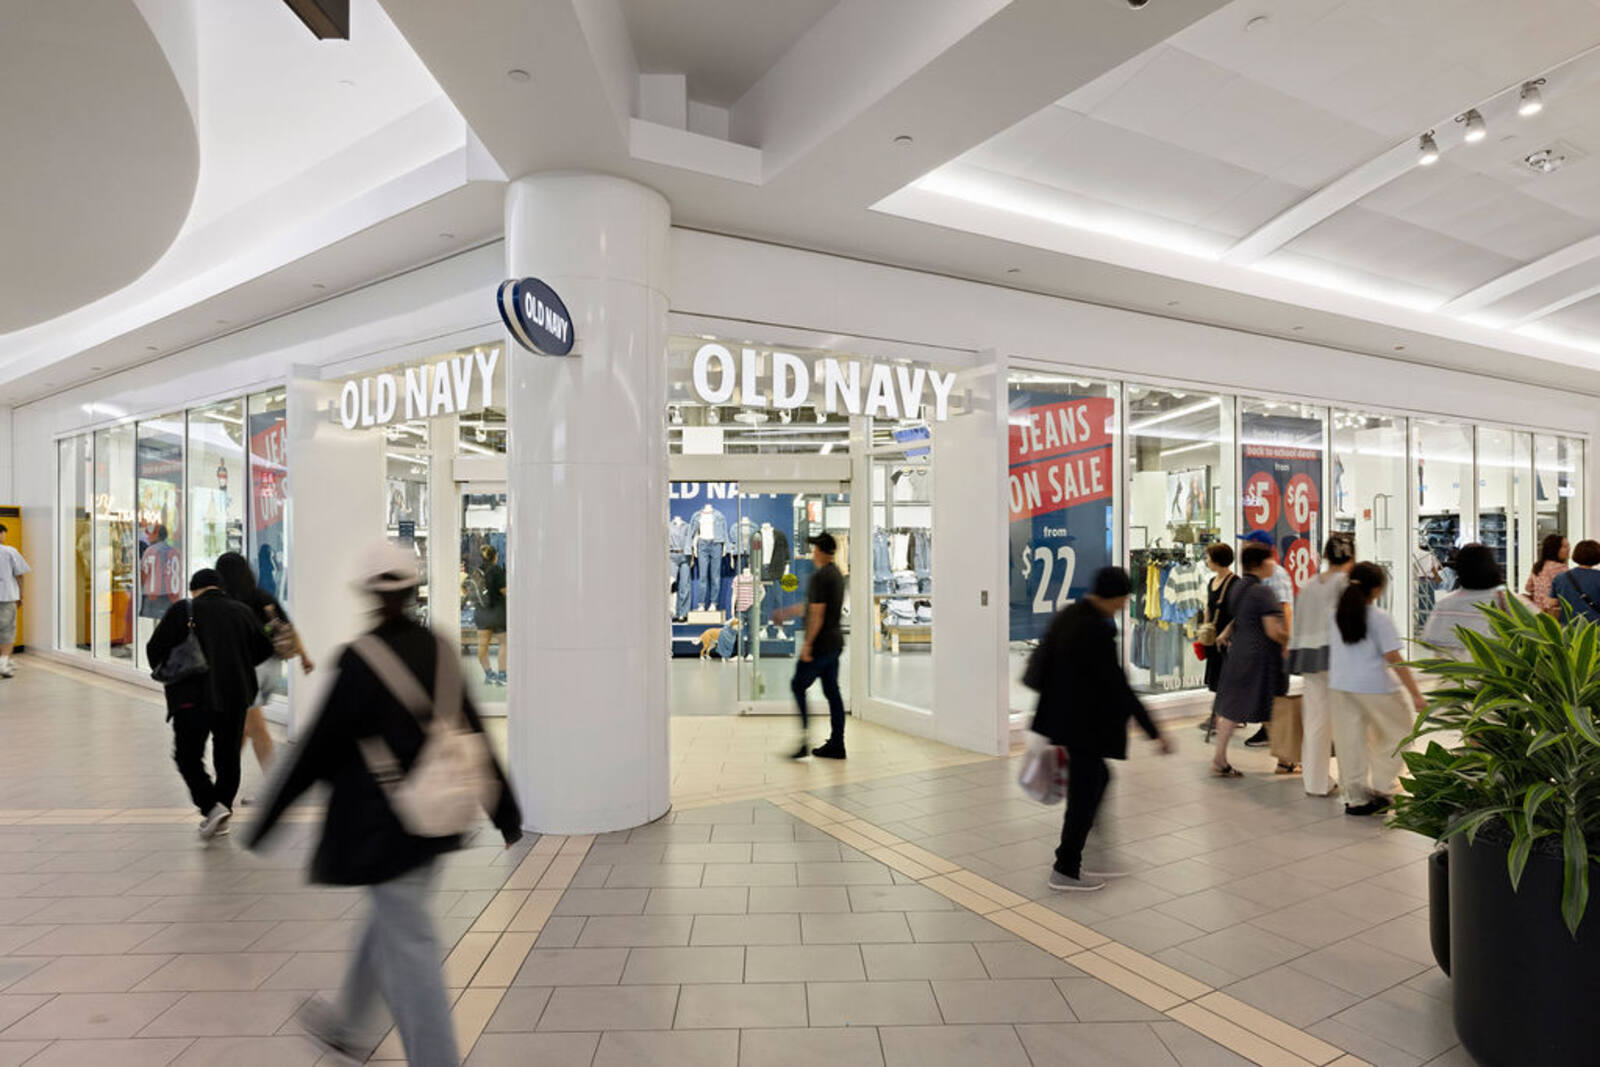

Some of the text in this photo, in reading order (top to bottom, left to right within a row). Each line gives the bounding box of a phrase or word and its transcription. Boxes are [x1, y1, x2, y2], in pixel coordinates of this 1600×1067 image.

[525, 292, 568, 343] OLD NAVY
[340, 348, 500, 430] OLD NAVY
[693, 343, 957, 421] OLD NAVY
[1019, 404, 1091, 455] JEANS
[668, 482, 699, 499] LD
[1008, 456, 1104, 513] ON SALE
[1274, 462, 1290, 471] from
[1247, 481, 1309, 524] $5 $6
[1043, 526, 1067, 538] from
[1022, 545, 1076, 613] $22
[1288, 547, 1309, 588] $8
